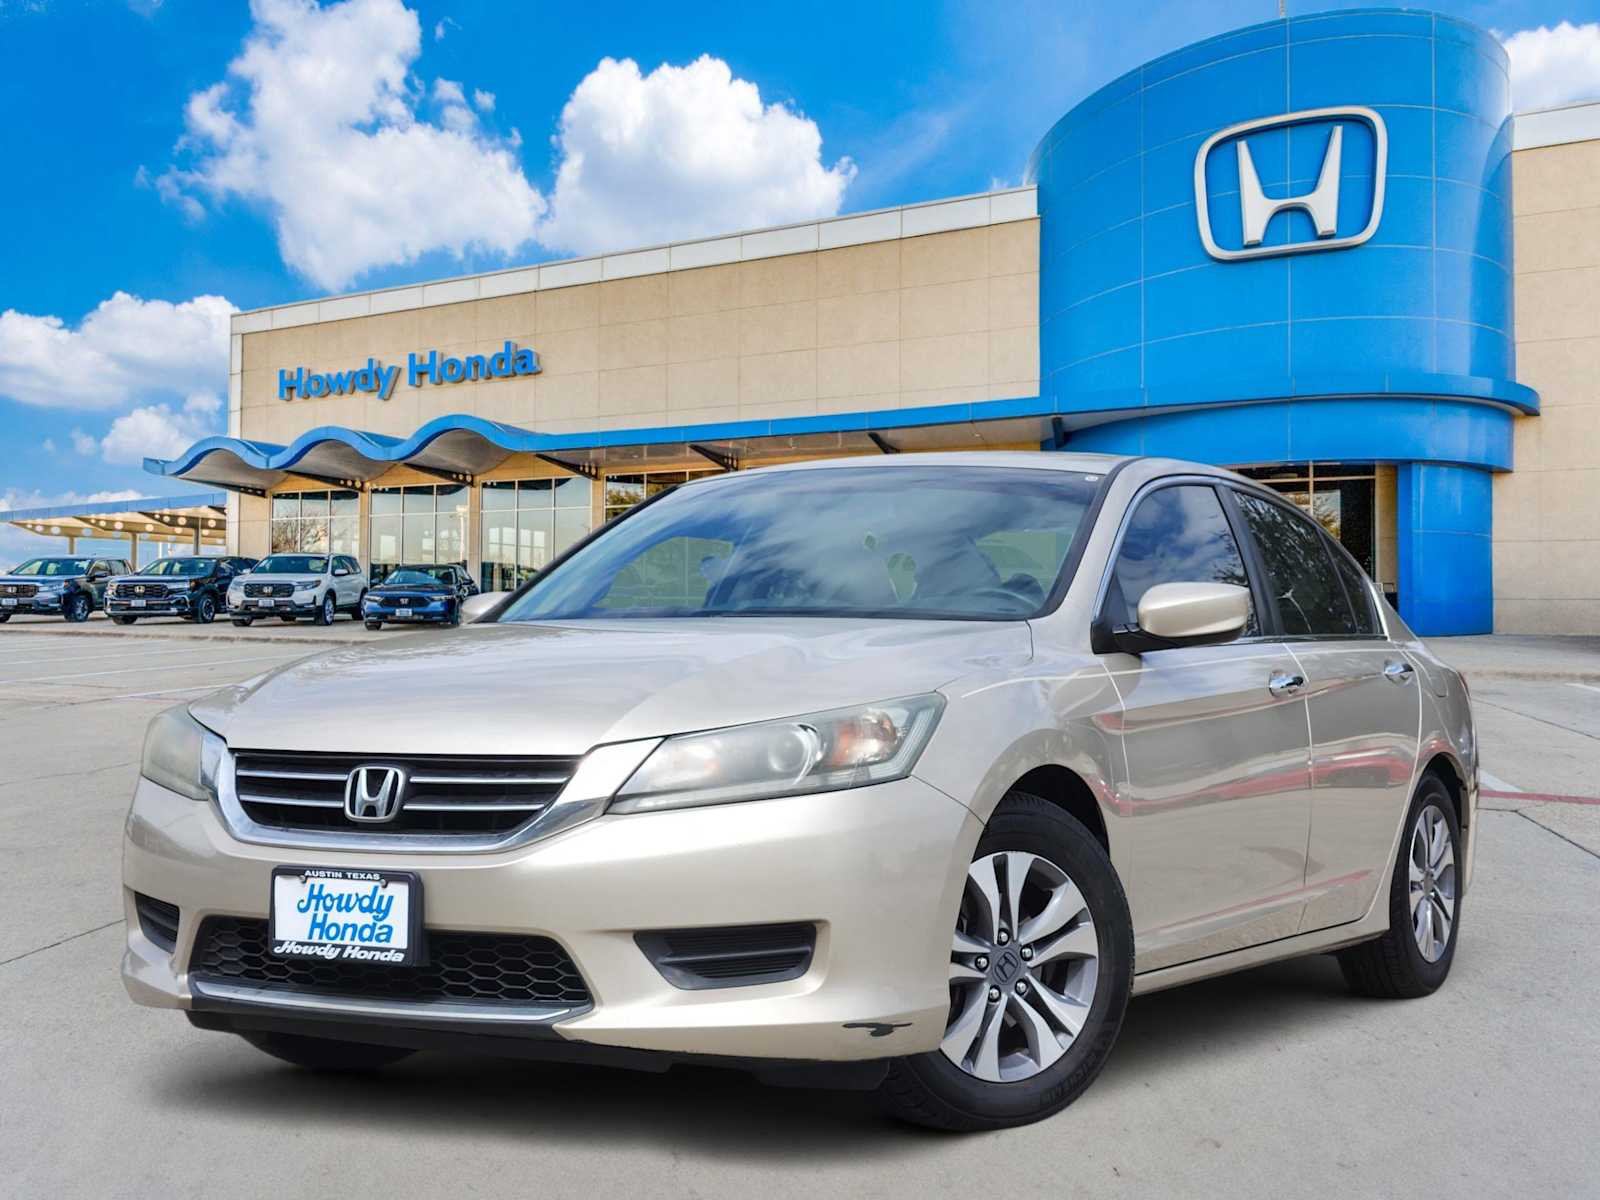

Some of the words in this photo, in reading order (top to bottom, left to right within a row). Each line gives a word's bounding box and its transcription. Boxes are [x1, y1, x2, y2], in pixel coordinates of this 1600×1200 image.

[278, 358, 400, 400] Howdy
[408, 341, 542, 388] Honda
[304, 870, 342, 878] AUSTIN
[346, 872, 381, 881] TEXAS
[297, 883, 394, 922] Howdy
[307, 913, 394, 944] Honda
[273, 940, 341, 960] Howdy
[343, 946, 405, 962] Honda
